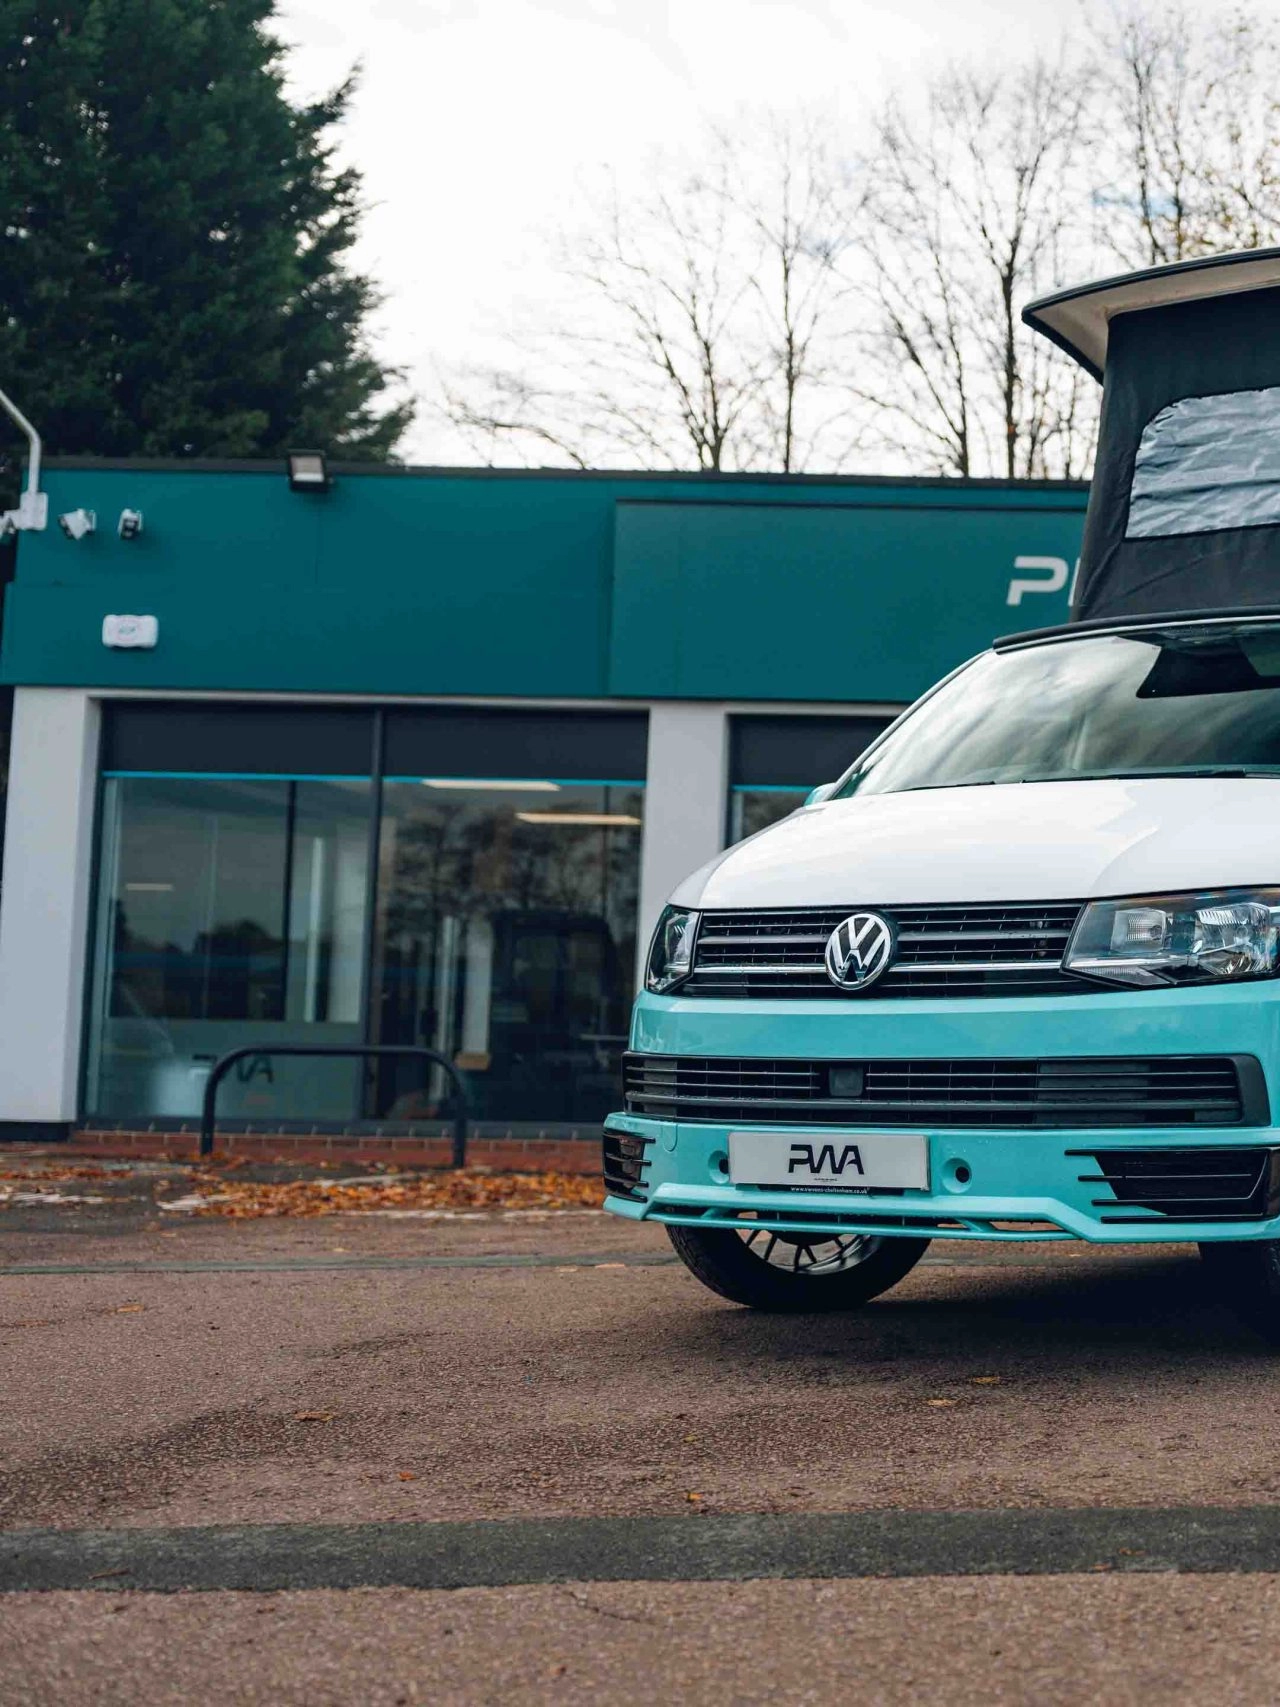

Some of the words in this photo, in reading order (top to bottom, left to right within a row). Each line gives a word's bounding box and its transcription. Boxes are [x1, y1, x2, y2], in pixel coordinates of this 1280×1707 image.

[1005, 555, 1082, 607] P
[828, 914, 889, 984] VW
[787, 1143, 865, 1175] PWA
